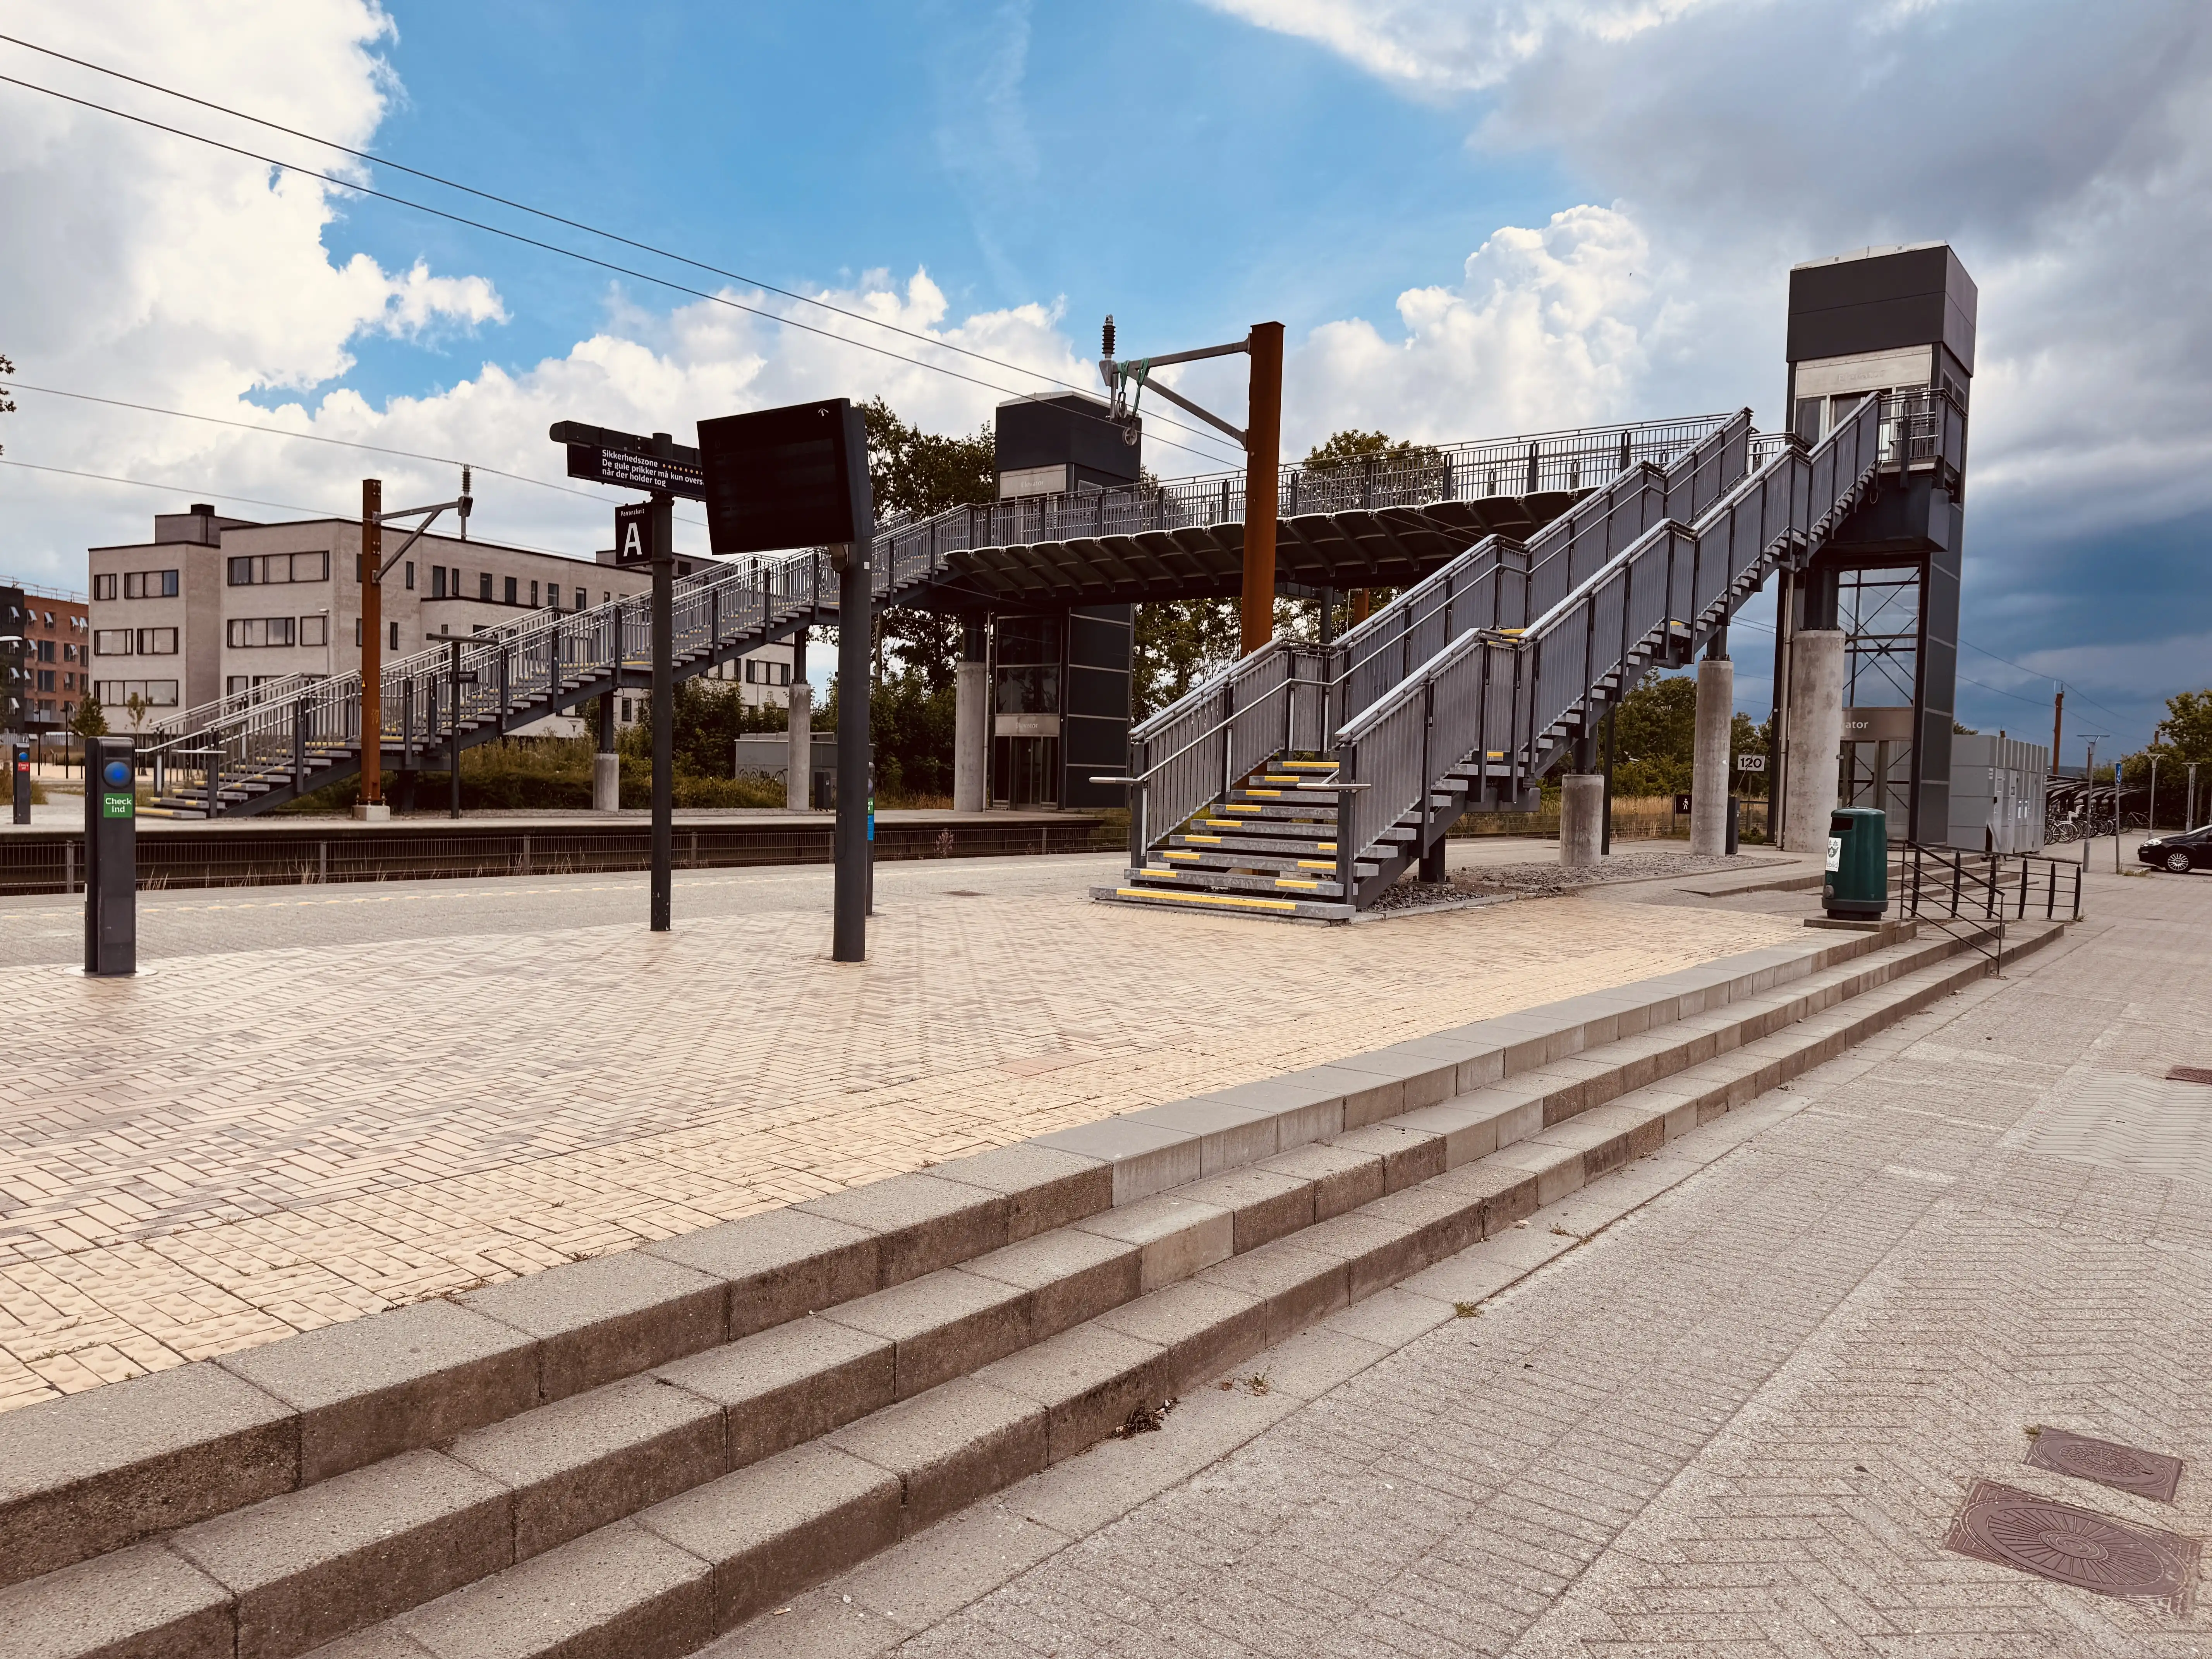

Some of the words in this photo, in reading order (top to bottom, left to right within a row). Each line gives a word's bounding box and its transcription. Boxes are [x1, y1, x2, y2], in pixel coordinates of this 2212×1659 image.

[602, 449, 658, 467] Sikkerhedszone
[602, 459, 612, 467] De
[614, 462, 630, 471] gule
[632, 465, 657, 476] prikker
[658, 470, 668, 478] må
[670, 472, 683, 481] kun
[685, 477, 704, 485] overs
[602, 468, 615, 476] når
[616, 471, 628, 479] der
[630, 472, 653, 484] holder
[654, 478, 666, 488] tog
[623, 522, 642, 557] A
[1740, 757, 1762, 768] 120
